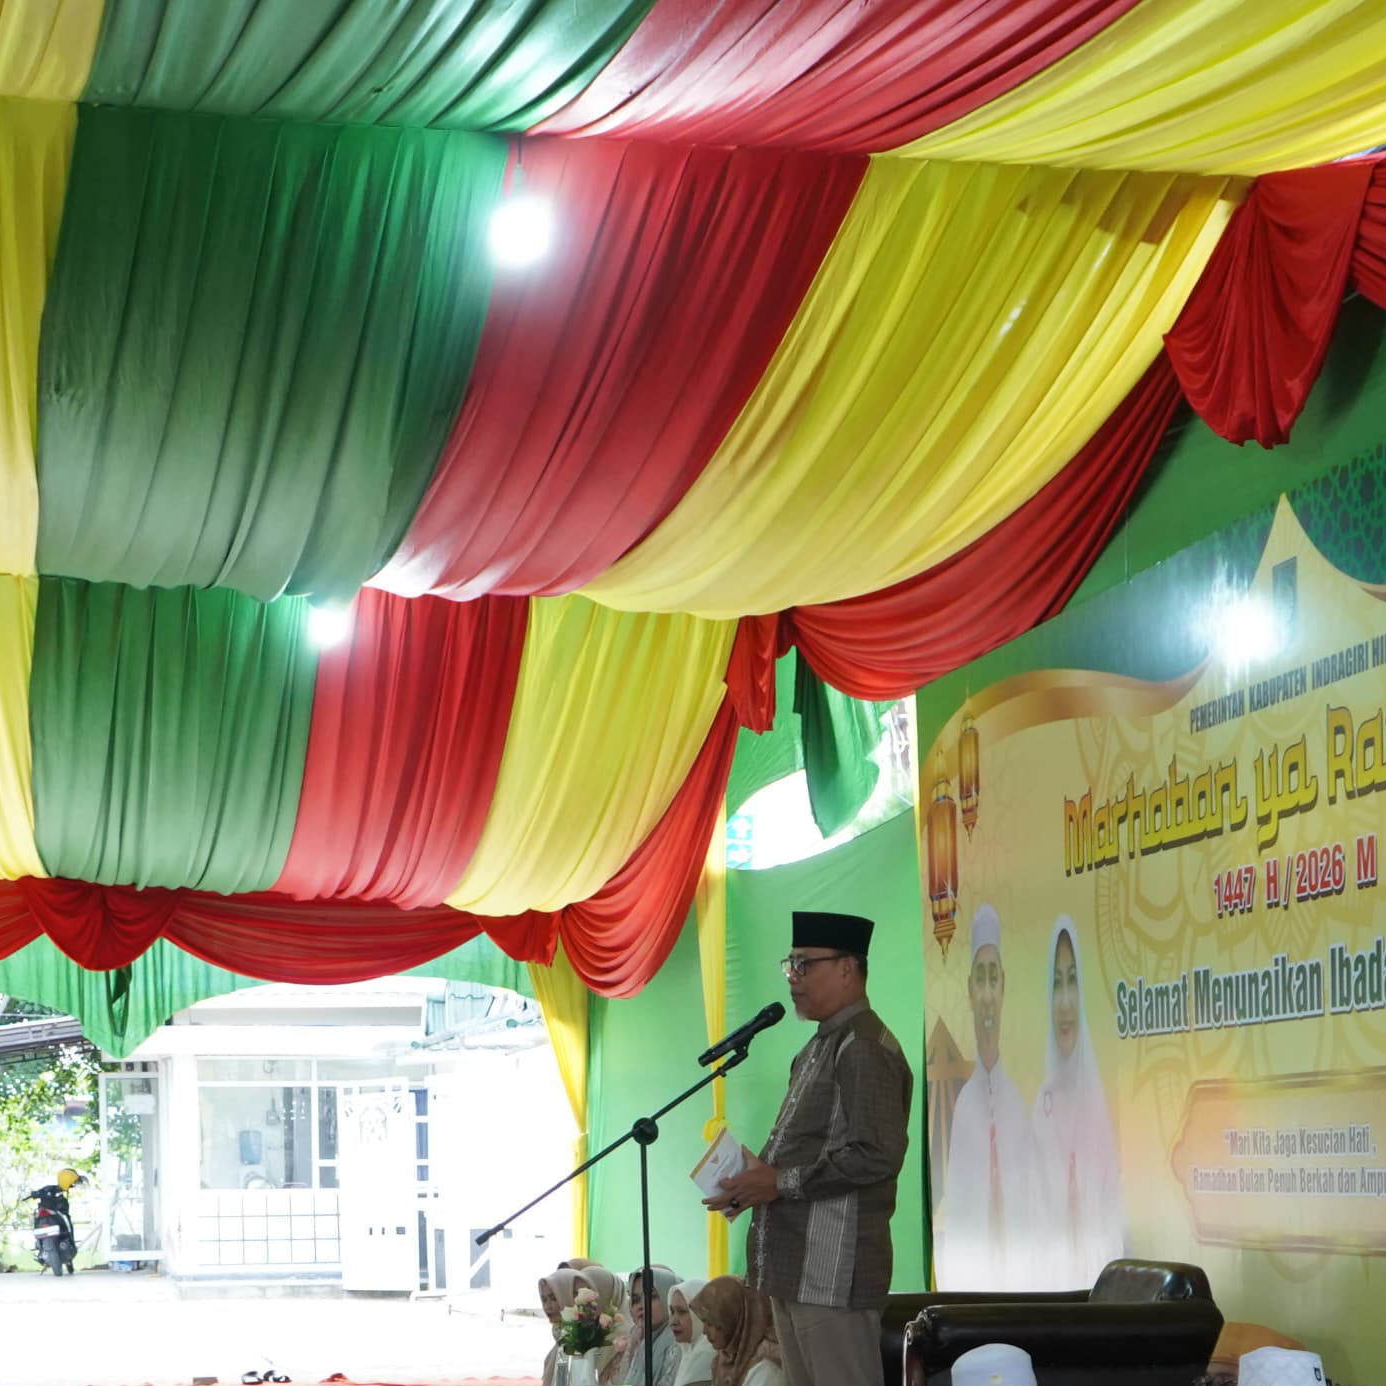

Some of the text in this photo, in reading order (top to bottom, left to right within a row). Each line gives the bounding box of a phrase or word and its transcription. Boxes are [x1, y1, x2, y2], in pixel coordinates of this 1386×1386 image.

[1190, 689, 1245, 734] PEMERINTAH
[1249, 666, 1307, 712] KABUPATEN
[1312, 641, 1369, 690] INDRAGIRI
[1064, 753, 1248, 877] Marhaban
[1254, 733, 1318, 856] ya
[1214, 866, 1256, 918] 1447
[1265, 859, 1280, 909] H
[1296, 843, 1346, 902] 2026
[1356, 833, 1378, 889] M
[1116, 970, 1189, 1038] Selamat
[1193, 953, 1324, 1030] Menunaikan
[1193, 1168, 1237, 1192] Ramadhan
[1239, 1167, 1263, 1192] Bulan
[1267, 1168, 1296, 1193] Penuh
[1300, 1168, 1335, 1193] Berkah
[1338, 1168, 1356, 1193] dan
[1252, 1129, 1271, 1155] Kita
[1273, 1130, 1297, 1157] Jaga
[1299, 1127, 1346, 1154] Kesucian
